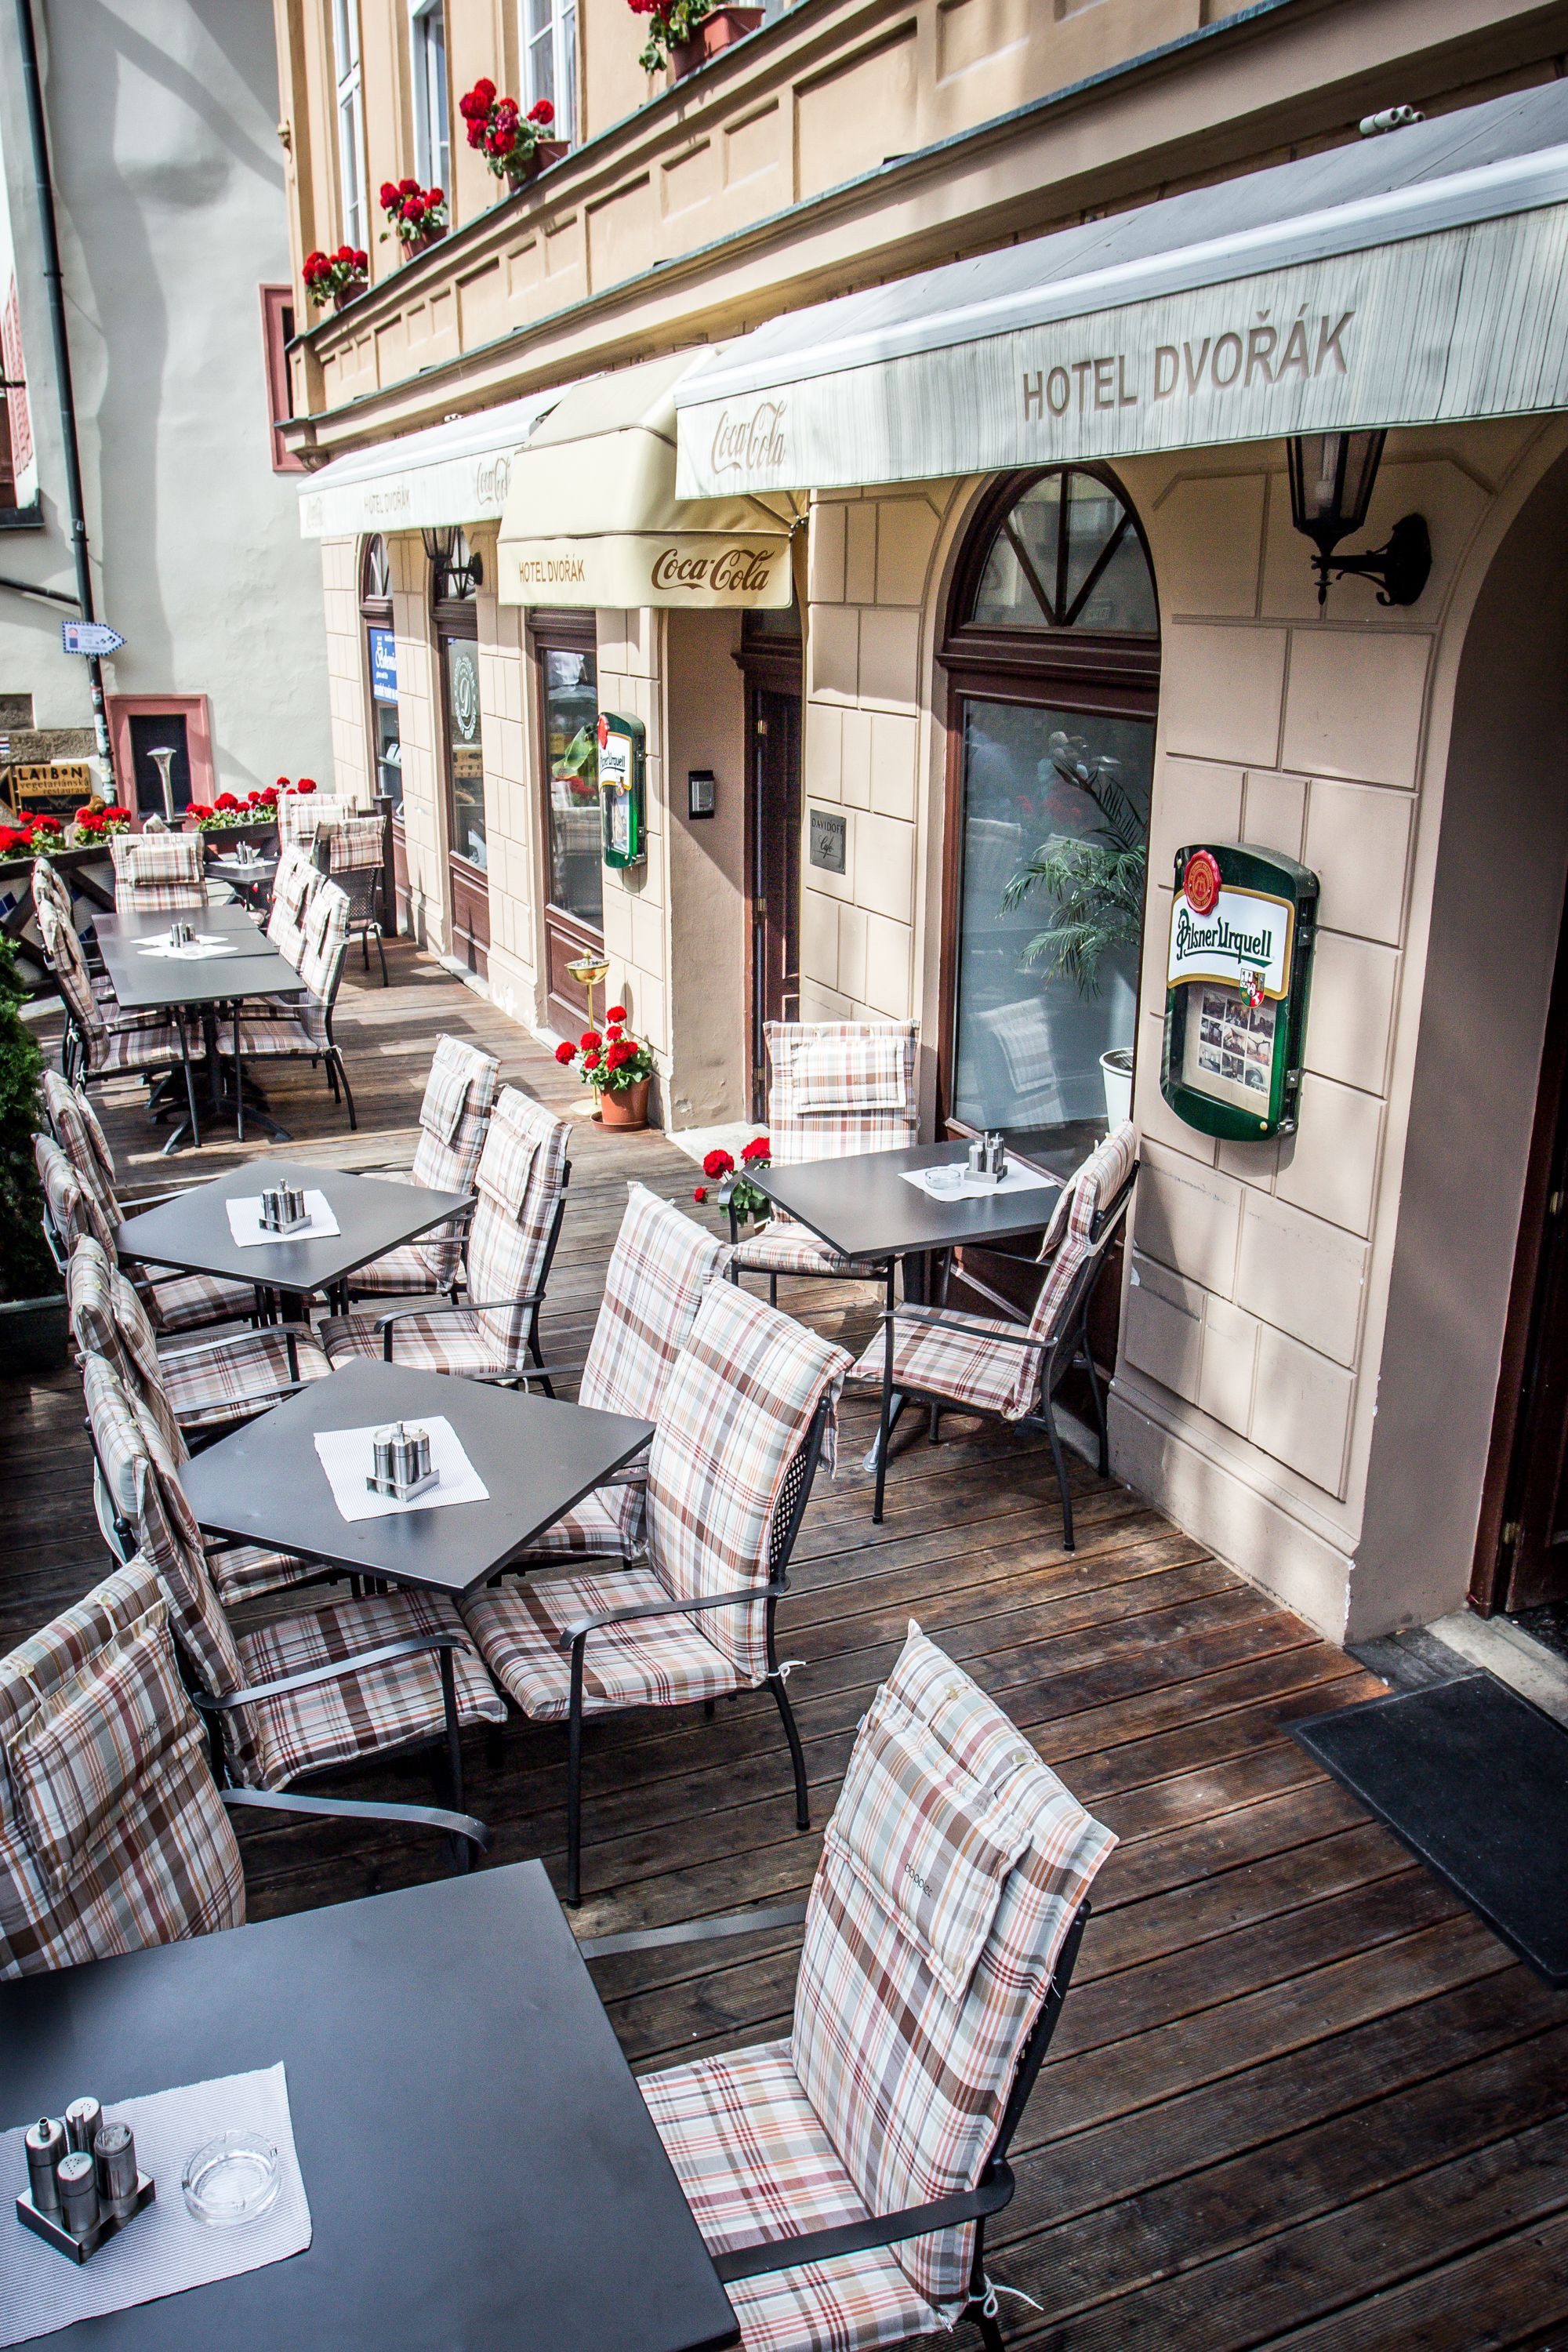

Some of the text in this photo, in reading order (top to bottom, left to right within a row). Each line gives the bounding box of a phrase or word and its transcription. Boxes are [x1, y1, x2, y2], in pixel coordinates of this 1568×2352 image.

[1022, 303, 1356, 422] HOTEL DVOŘÁK
[518, 553, 585, 583] HOTEL DVOŘÁK
[651, 549, 775, 591] Coca-Cola
[43, 786, 91, 795] restaurace
[811, 818, 844, 835] DAVIDOFF
[1176, 908, 1272, 965] Pilsner Urquell
